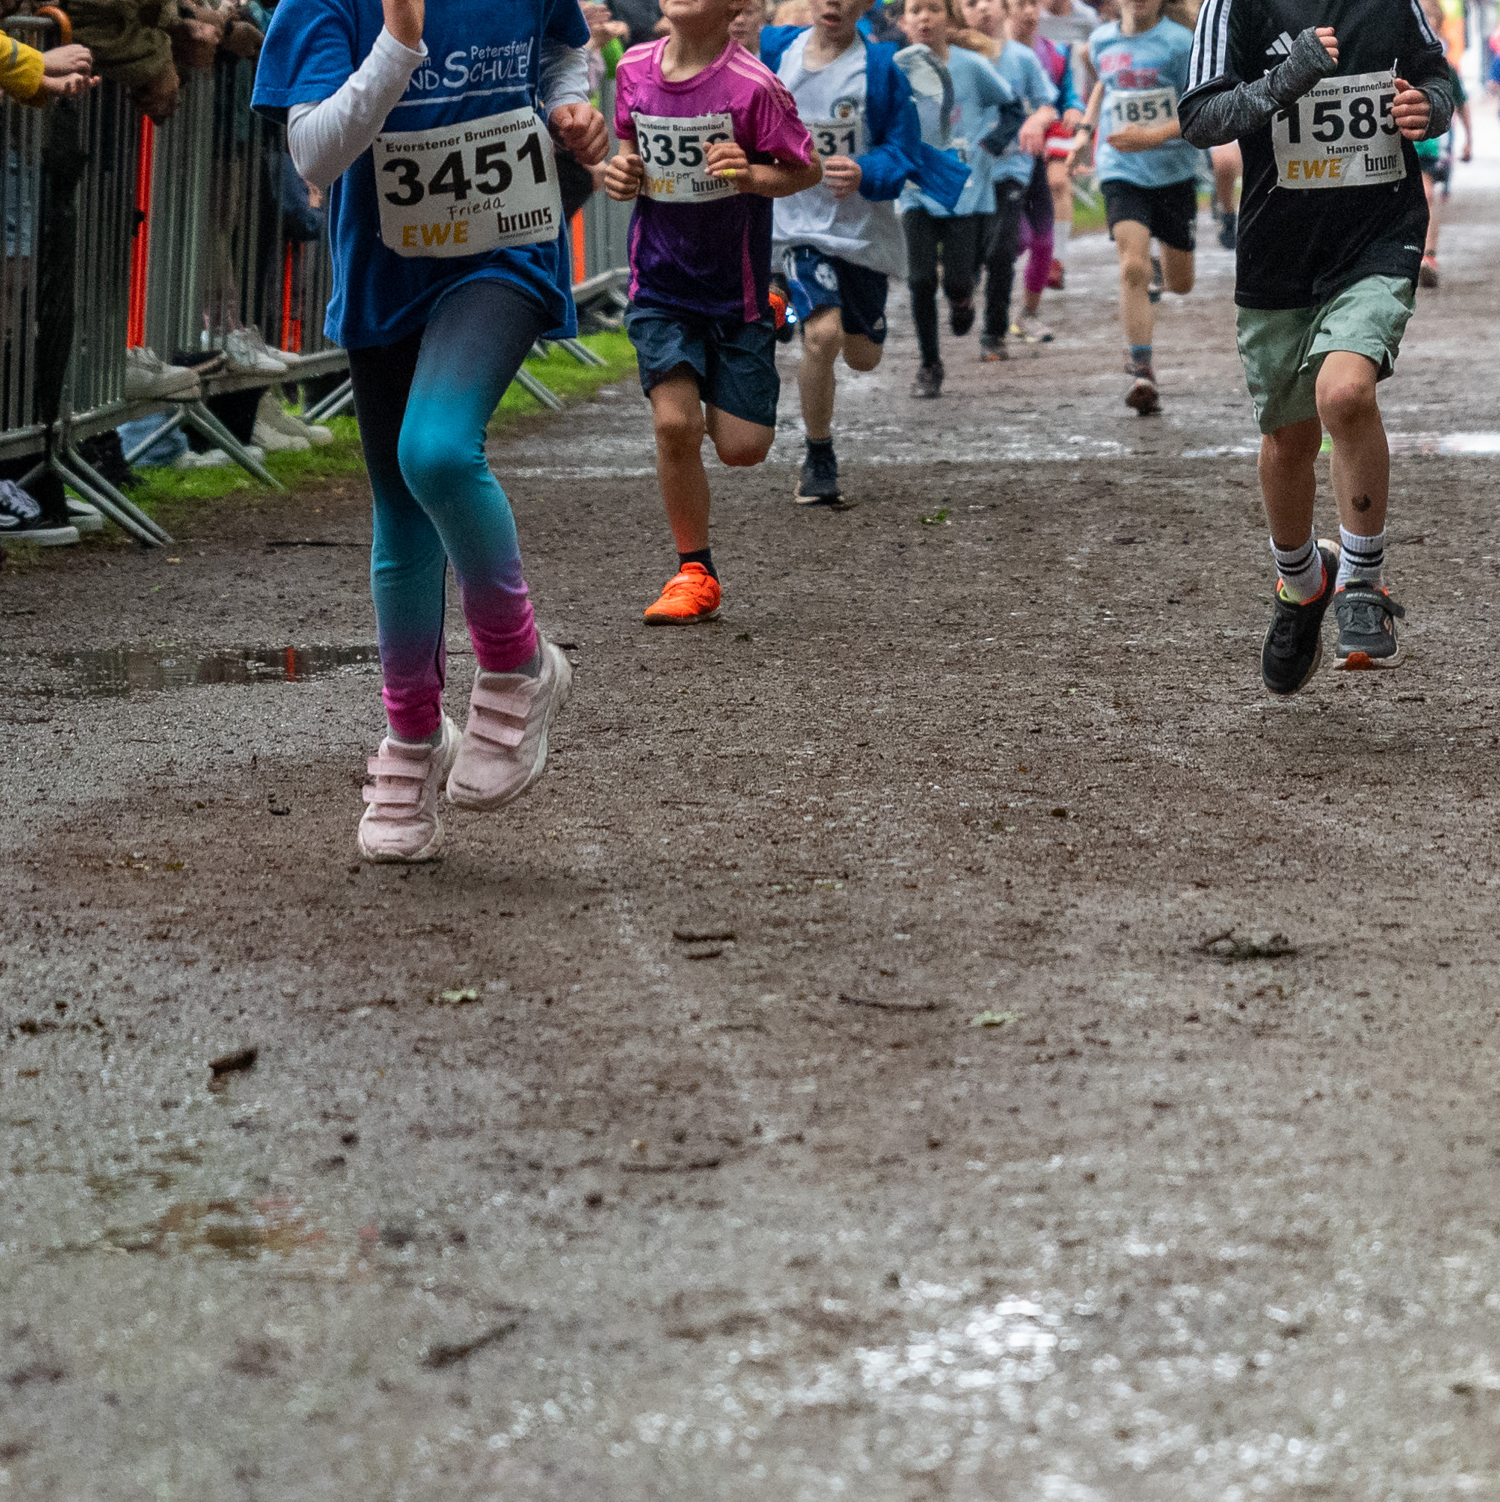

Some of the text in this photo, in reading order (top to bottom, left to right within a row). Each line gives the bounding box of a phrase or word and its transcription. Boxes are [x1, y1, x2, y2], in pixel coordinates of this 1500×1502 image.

[1342, 80, 1394, 95] Brunnenlauf
[1114, 99, 1174, 122] 1851
[1277, 93, 1400, 144] 1585
[386, 115, 537, 153] Everstener Brunnenlauf
[672, 121, 725, 132] Brunnenlauf
[817, 129, 856, 156] 31
[1326, 144, 1370, 155] Hannes
[382, 131, 548, 207] 3451
[1287, 157, 1343, 180] EWE
[650, 177, 676, 195] WE
[447, 197, 506, 221] Frieda
[402, 220, 469, 247] EWE
[497, 206, 553, 234] bruns
